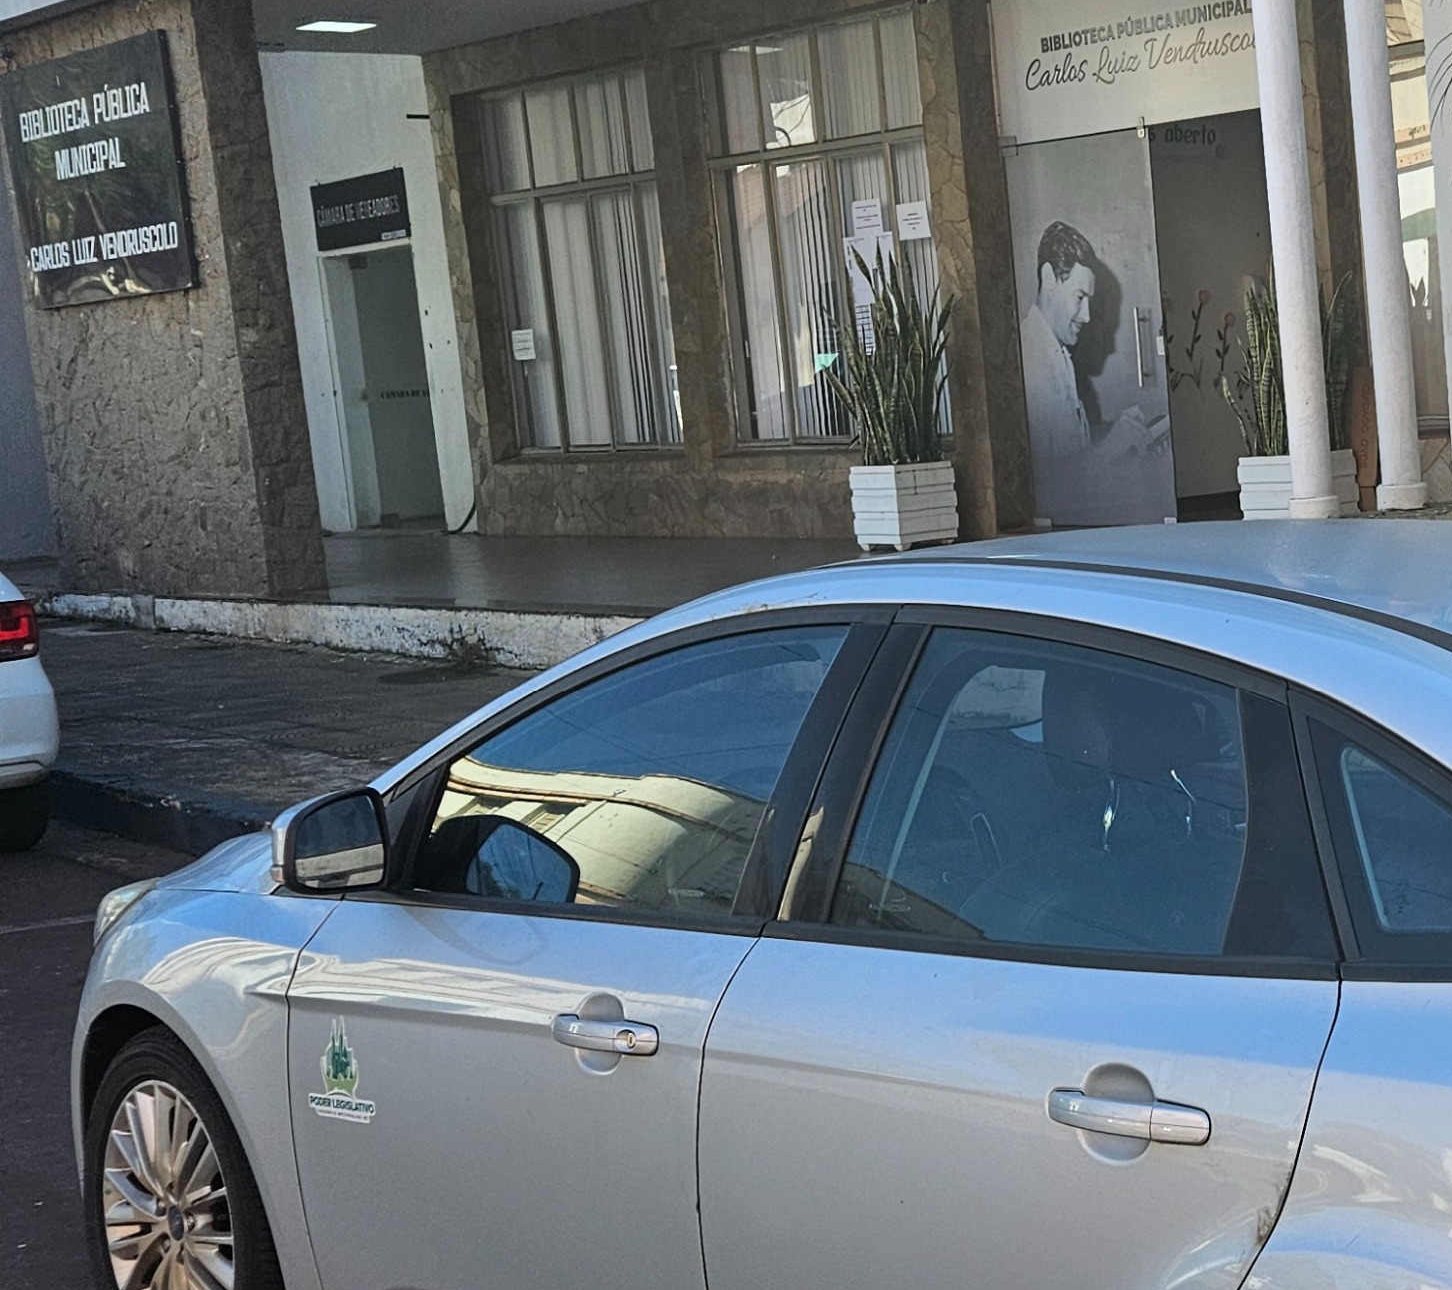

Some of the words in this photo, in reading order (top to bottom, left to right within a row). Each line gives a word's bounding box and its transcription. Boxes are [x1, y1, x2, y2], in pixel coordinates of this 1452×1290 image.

[1040, 24, 1115, 54] BIBLIOTECA
[1116, 12, 1174, 39] PÚBLICA
[1026, 52, 1088, 91] Carlos
[1092, 45, 1141, 85] Luiz
[19, 96, 91, 143] BIBLIOTECA
[93, 81, 150, 125] PÚBLICA
[1164, 123, 1216, 145] aberto
[54, 137, 126, 181] MUNICIPAL
[30, 243, 71, 273] CARLOS
[72, 236, 98, 266] LUIZ
[99, 222, 179, 261] VENDRUSCOLO
